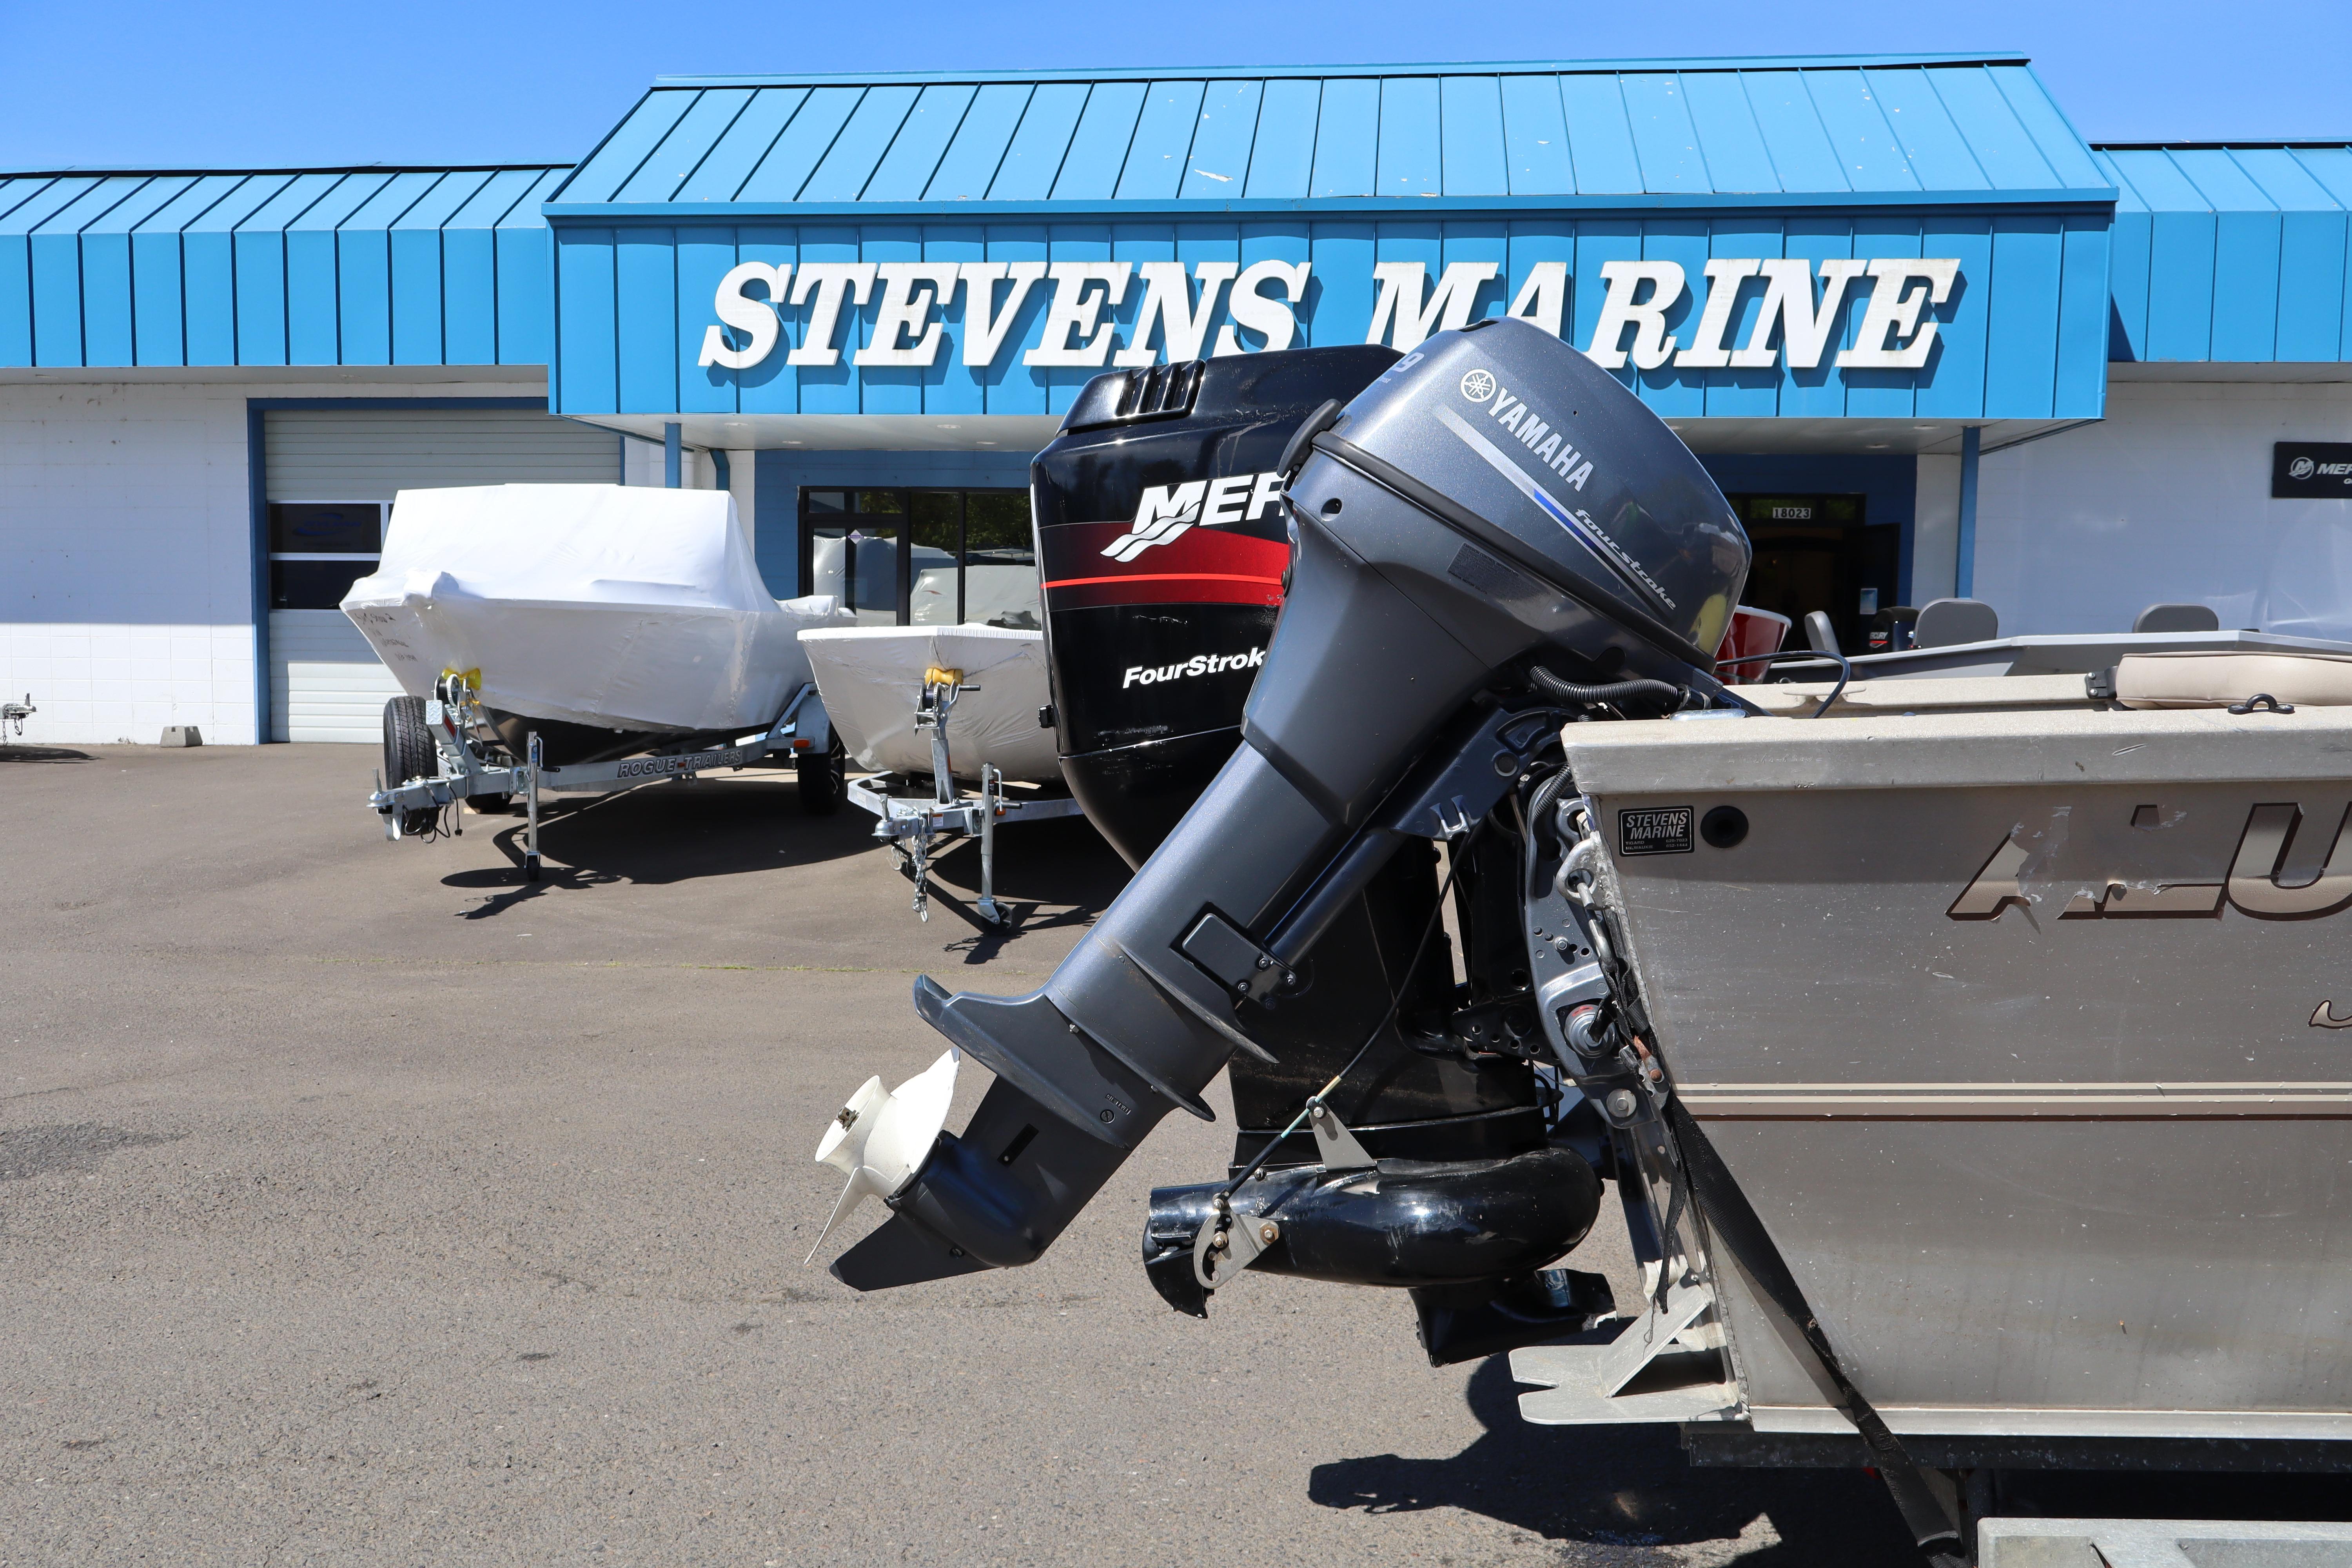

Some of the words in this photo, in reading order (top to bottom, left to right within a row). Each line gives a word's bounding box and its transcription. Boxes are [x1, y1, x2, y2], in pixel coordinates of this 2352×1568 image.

[698, 260, 1311, 369] STEVENS
[1367, 258, 1961, 370] MARINE
[1488, 387, 1594, 492] YAMAHA
[1775, 508, 1809, 518] 18023
[1123, 647, 1266, 689] FourStrok
[617, 758, 677, 778] ROGUE
[684, 750, 741, 770] TRAILERS
[1627, 812, 1688, 828] STEVENS
[1630, 825, 1685, 840] MARINE
